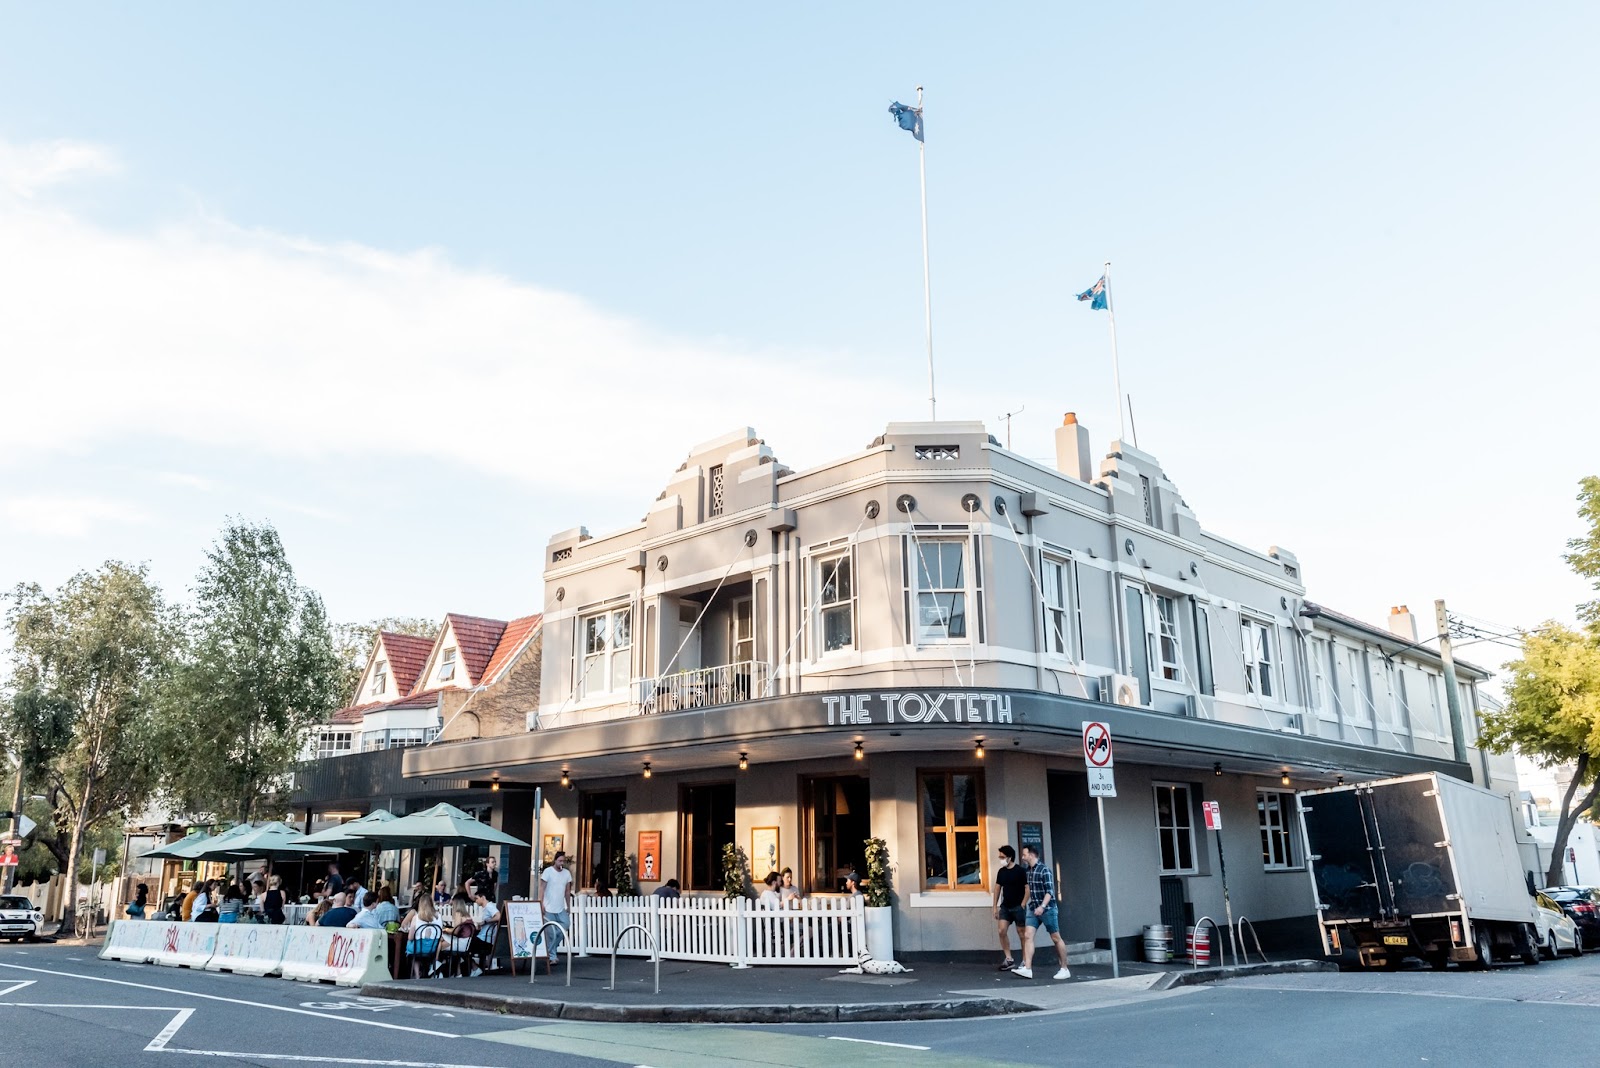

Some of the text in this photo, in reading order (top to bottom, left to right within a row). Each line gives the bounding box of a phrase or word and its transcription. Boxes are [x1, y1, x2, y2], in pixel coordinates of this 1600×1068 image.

[822, 692, 1012, 725] THE TOXTETH
[1091, 783, 1112, 791] AND OVER
